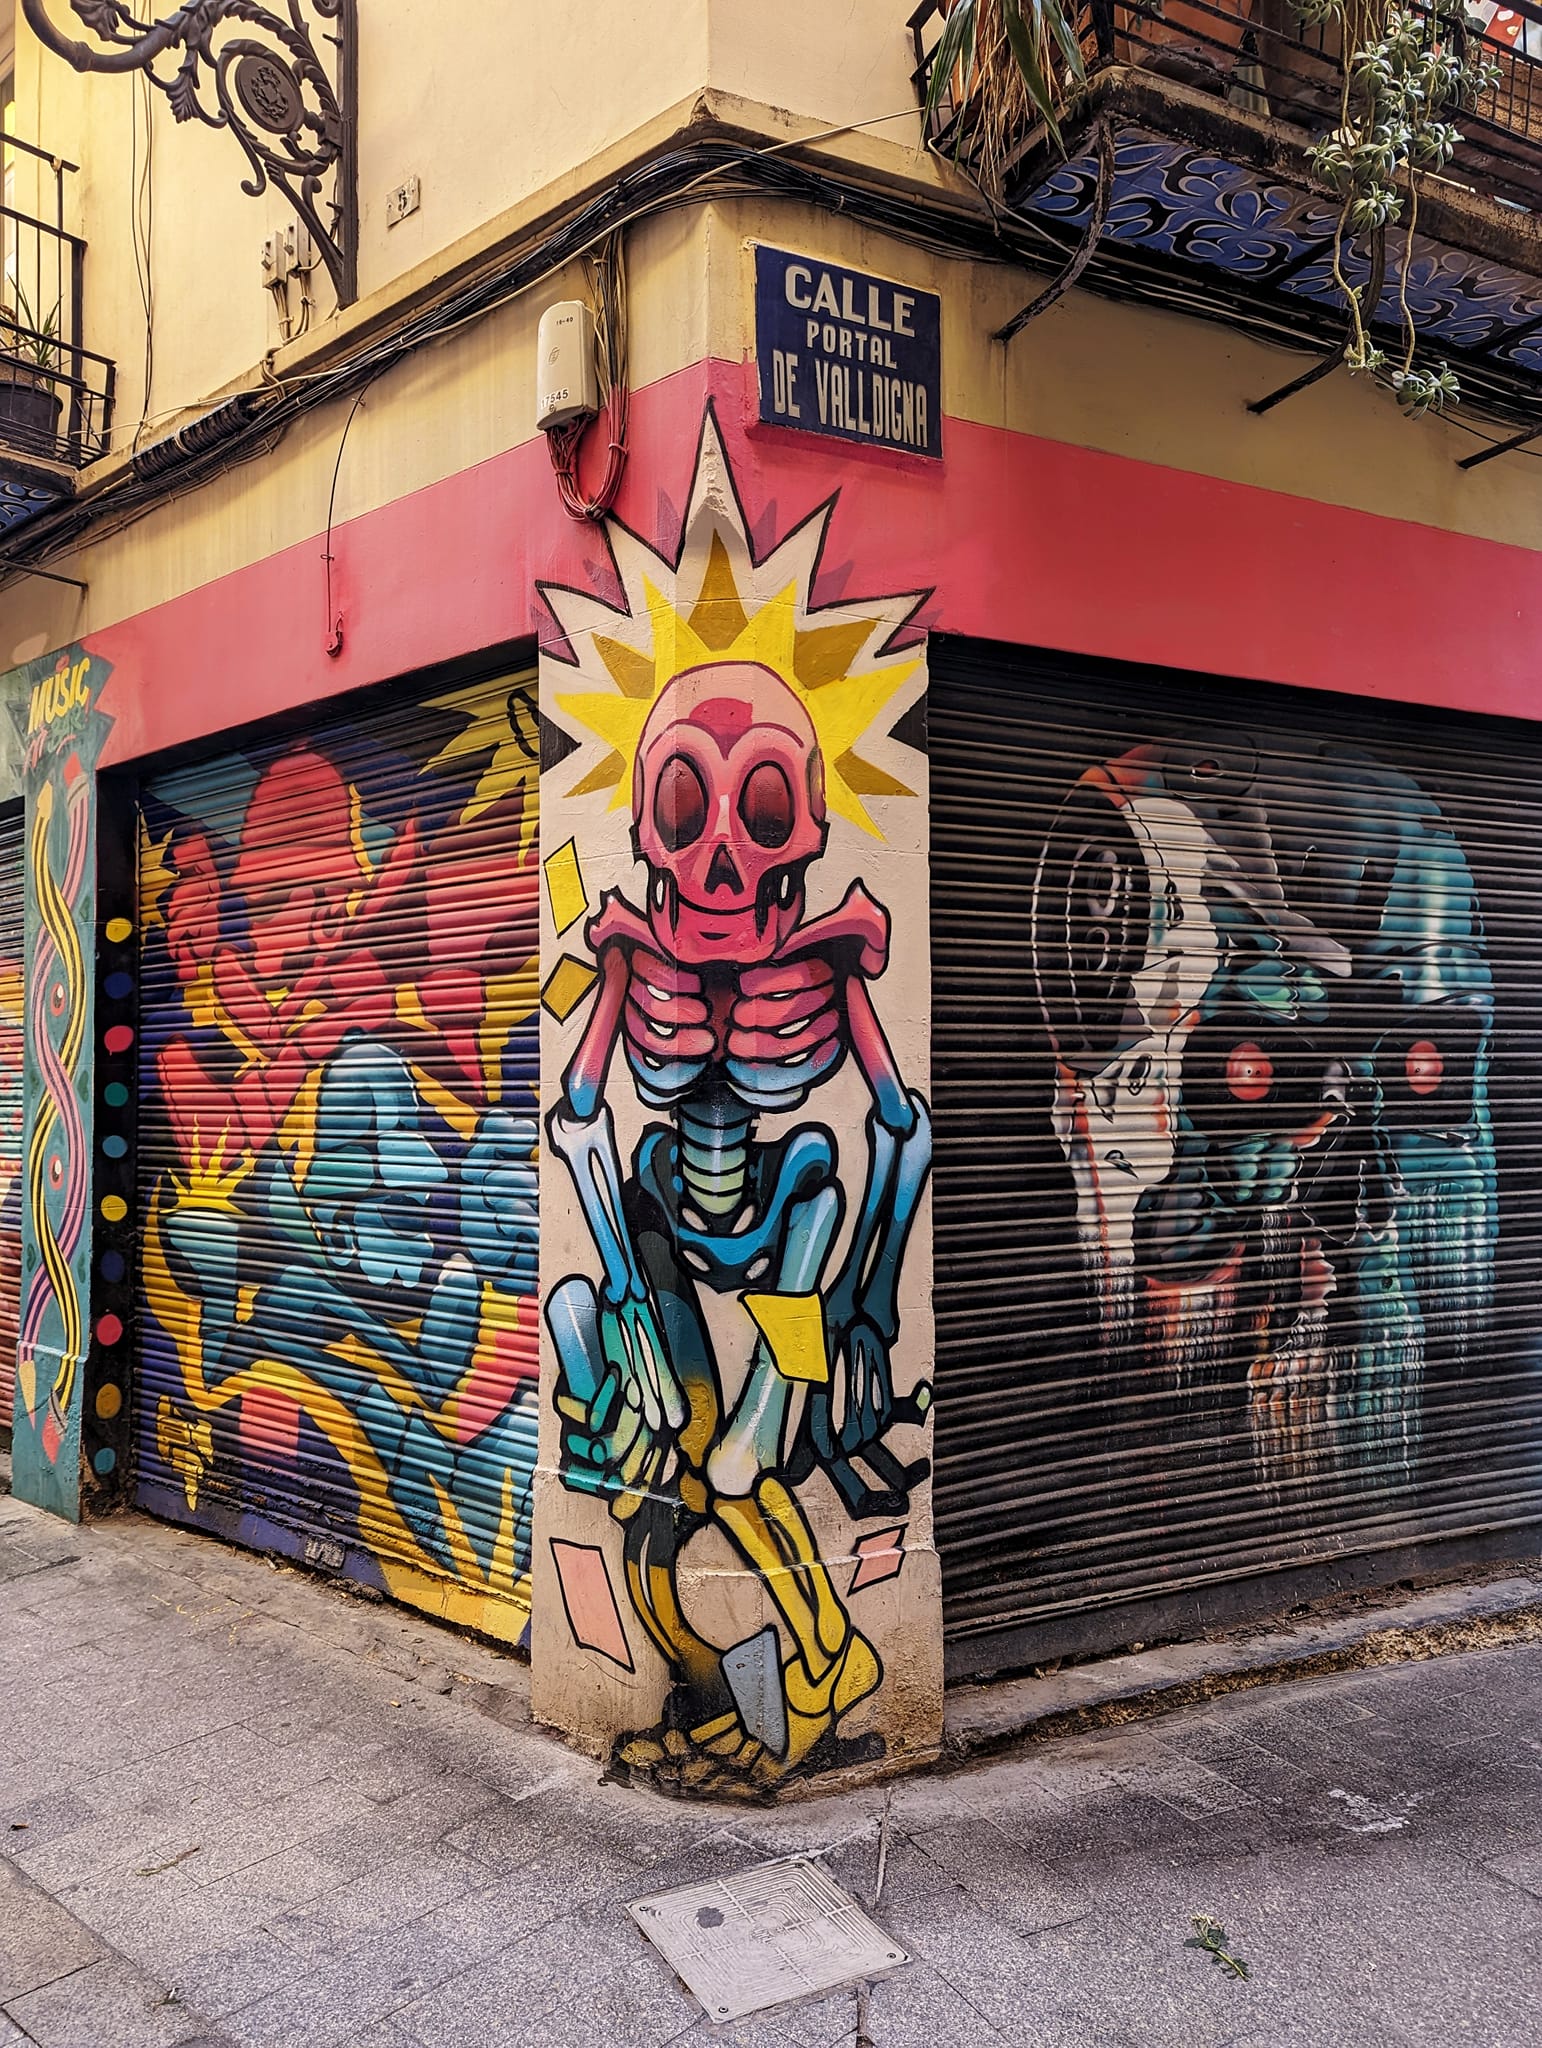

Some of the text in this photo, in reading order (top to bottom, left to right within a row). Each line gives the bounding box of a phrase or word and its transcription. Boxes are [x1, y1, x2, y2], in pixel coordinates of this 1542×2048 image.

[785, 264, 915, 337] CALLE
[806, 319, 897, 369] PORTAL
[773, 349, 928, 447] DE VALLDIGNA
[28, 657, 90, 735] MUSIC
